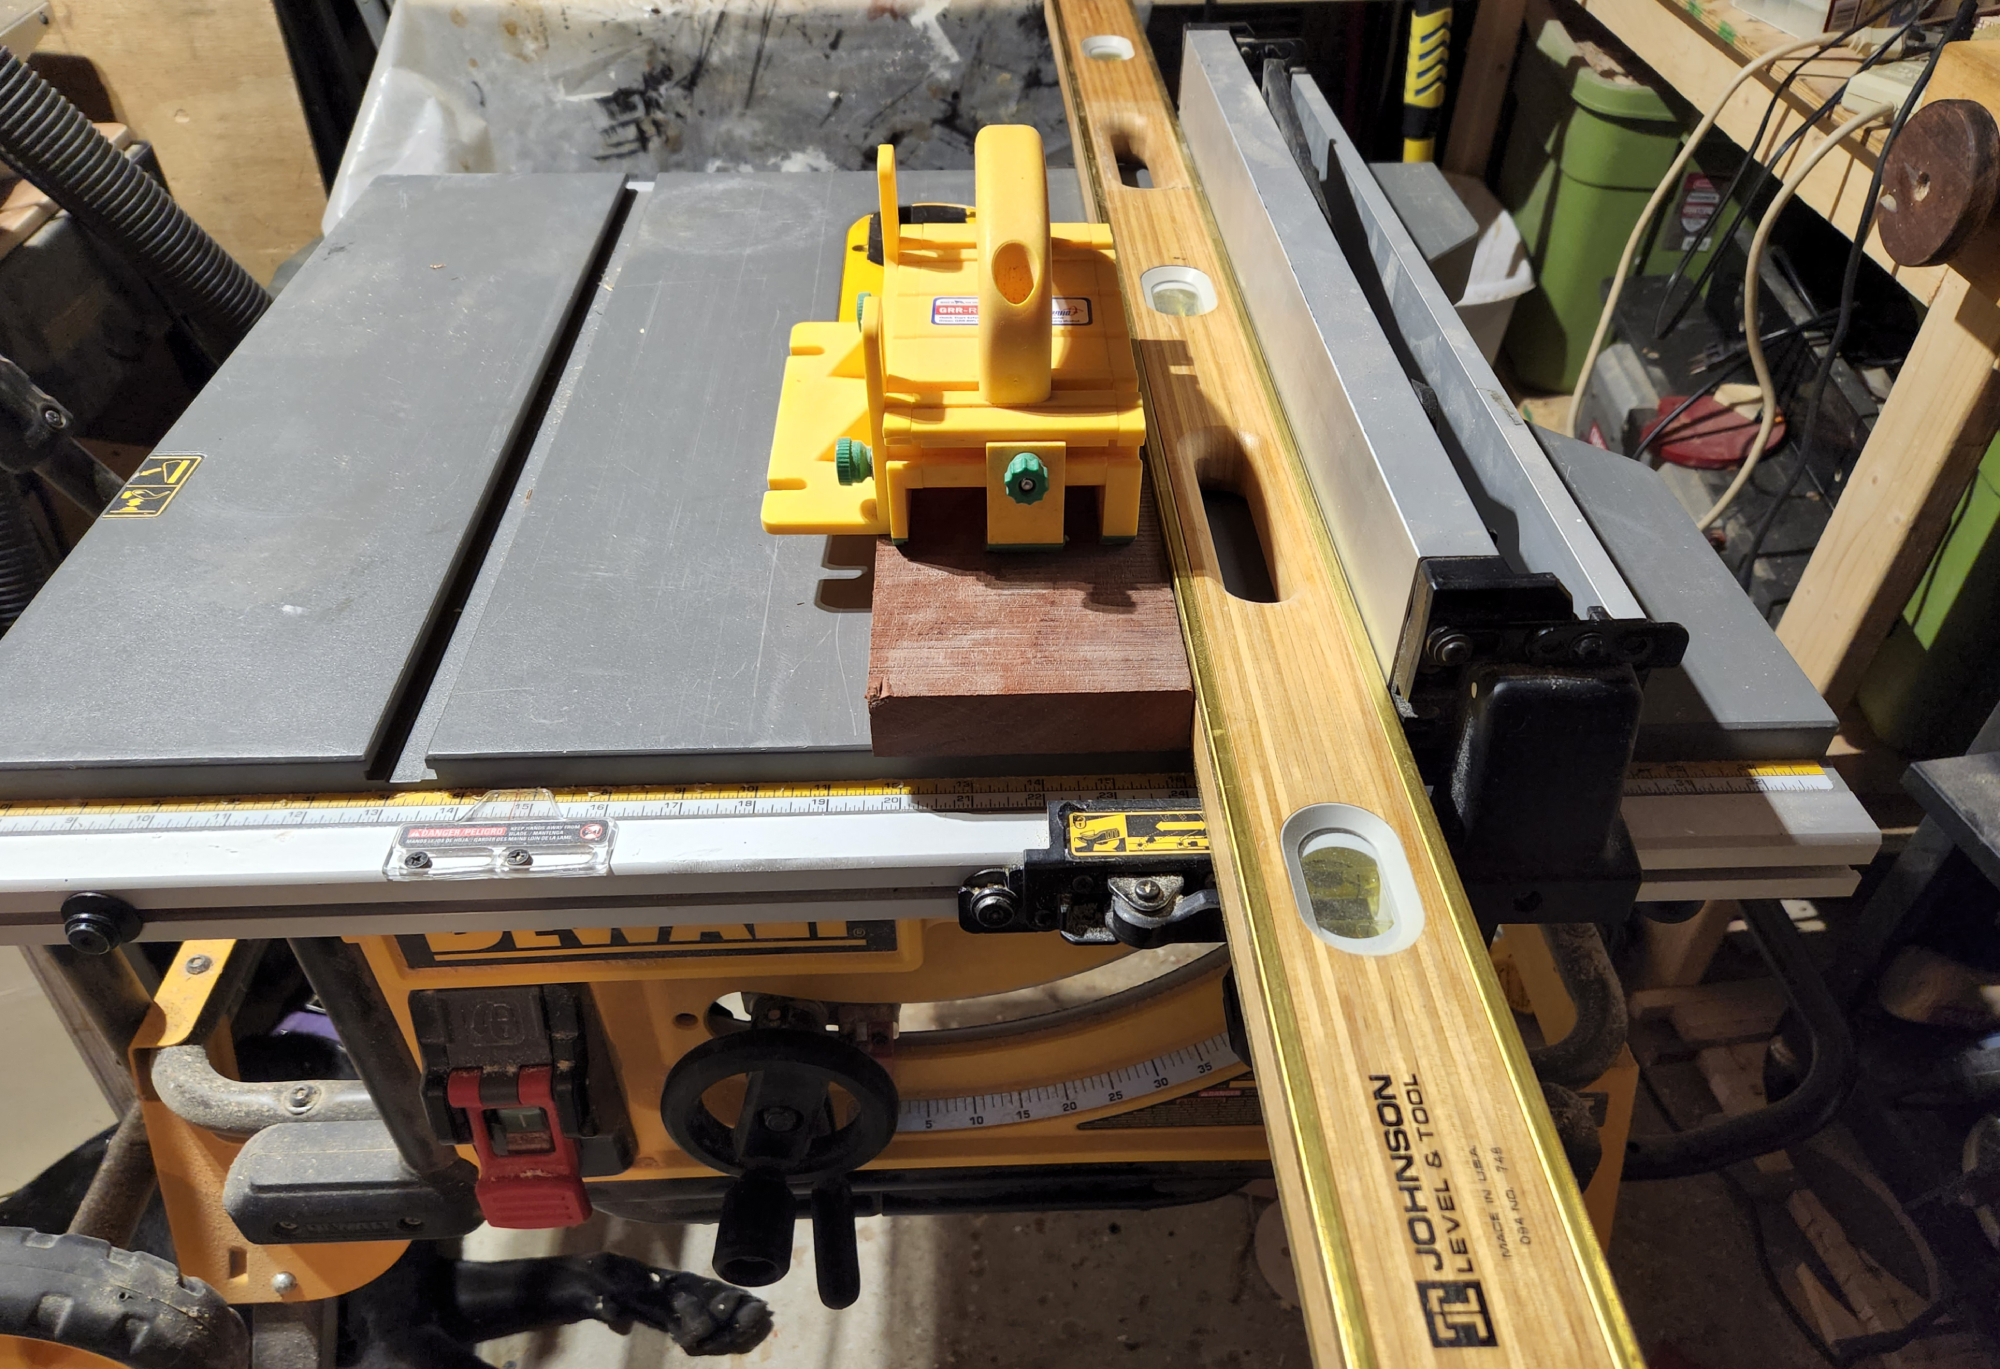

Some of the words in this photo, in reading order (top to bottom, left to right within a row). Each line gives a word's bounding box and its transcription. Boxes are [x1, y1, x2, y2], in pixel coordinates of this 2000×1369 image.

[939, 306, 978, 314] GRR-R
[812, 798, 826, 806] 19
[1098, 791, 1114, 799] 23
[925, 1119, 933, 1129] 5
[969, 1115, 984, 1125] 10
[1016, 1110, 1031, 1119] 15
[1062, 1101, 1078, 1112] 20
[1108, 1090, 1123, 1101] 25
[1153, 1077, 1169, 1089] 30
[1197, 1062, 1213, 1074] 35
[1403, 1073, 1434, 1142] TOOL
[1368, 1074, 1443, 1271] JOHNSON
[1424, 1149, 1443, 1168] &
[1482, 1188, 1494, 1204] IN
[1433, 1178, 1474, 1273] LEVEL
[1489, 1211, 1512, 1258] MADE
